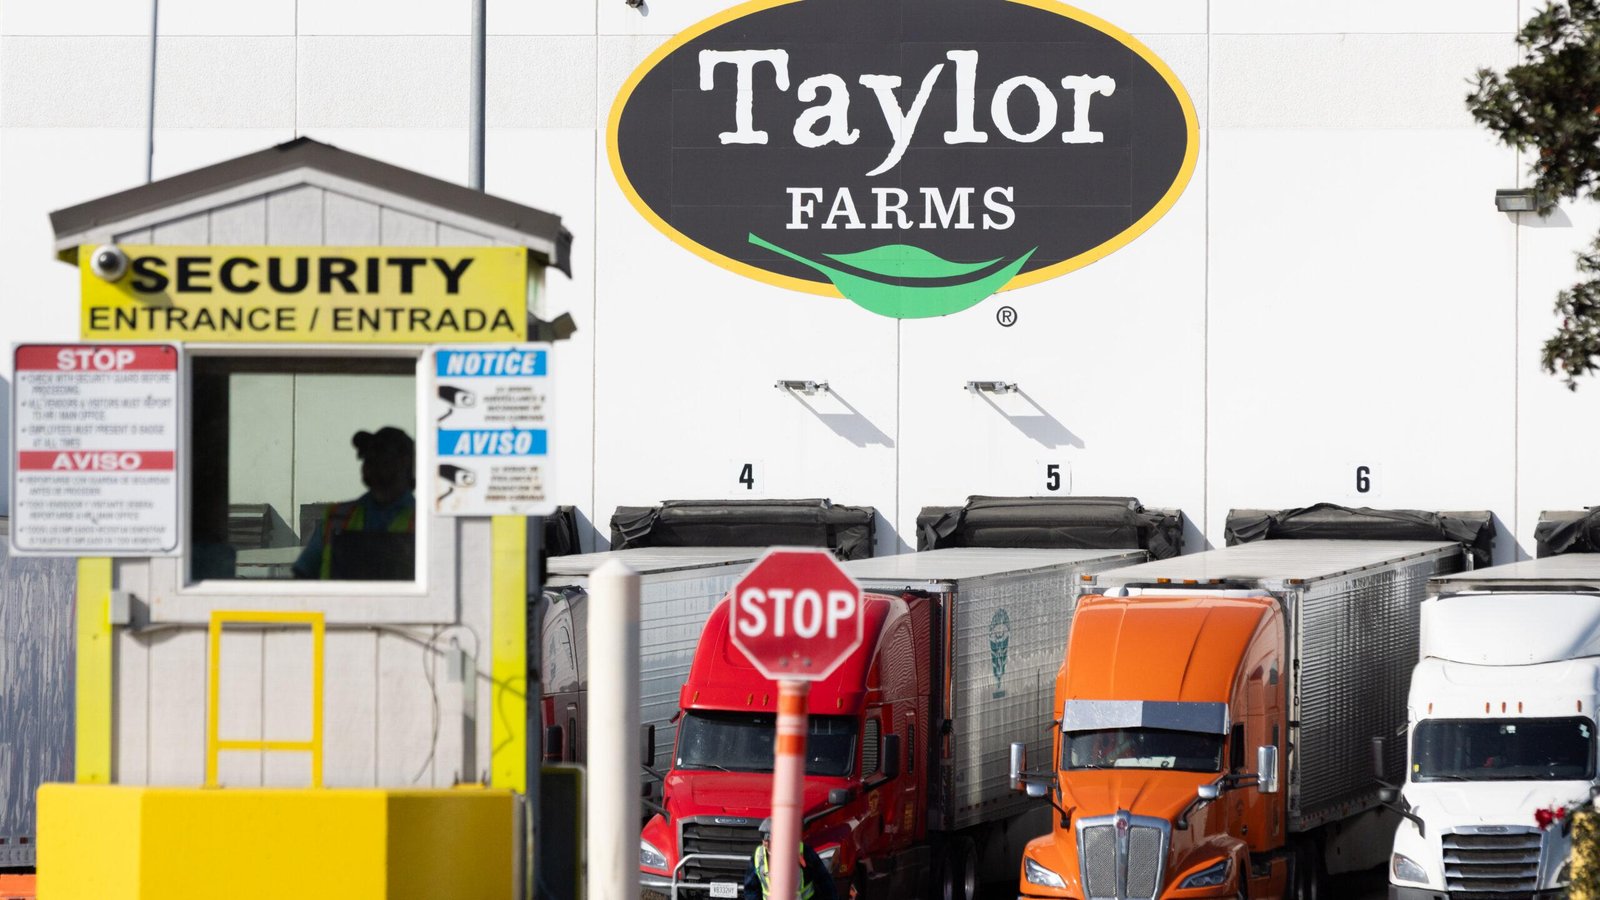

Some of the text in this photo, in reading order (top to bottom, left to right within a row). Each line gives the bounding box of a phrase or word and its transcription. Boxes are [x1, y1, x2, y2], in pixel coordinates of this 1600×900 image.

[698, 48, 1116, 176] Taylor
[786, 186, 1015, 230] FARMS
[130, 256, 473, 294] SECURITY
[90, 306, 515, 331] ENTRANCE / ENTRADA
[57, 348, 136, 370] STOP
[447, 352, 538, 375] NOTICE
[453, 431, 534, 455] AVISO
[52, 452, 142, 470] AVISO
[740, 464, 1370, 492] 4 5 6
[738, 588, 856, 638] STOP
